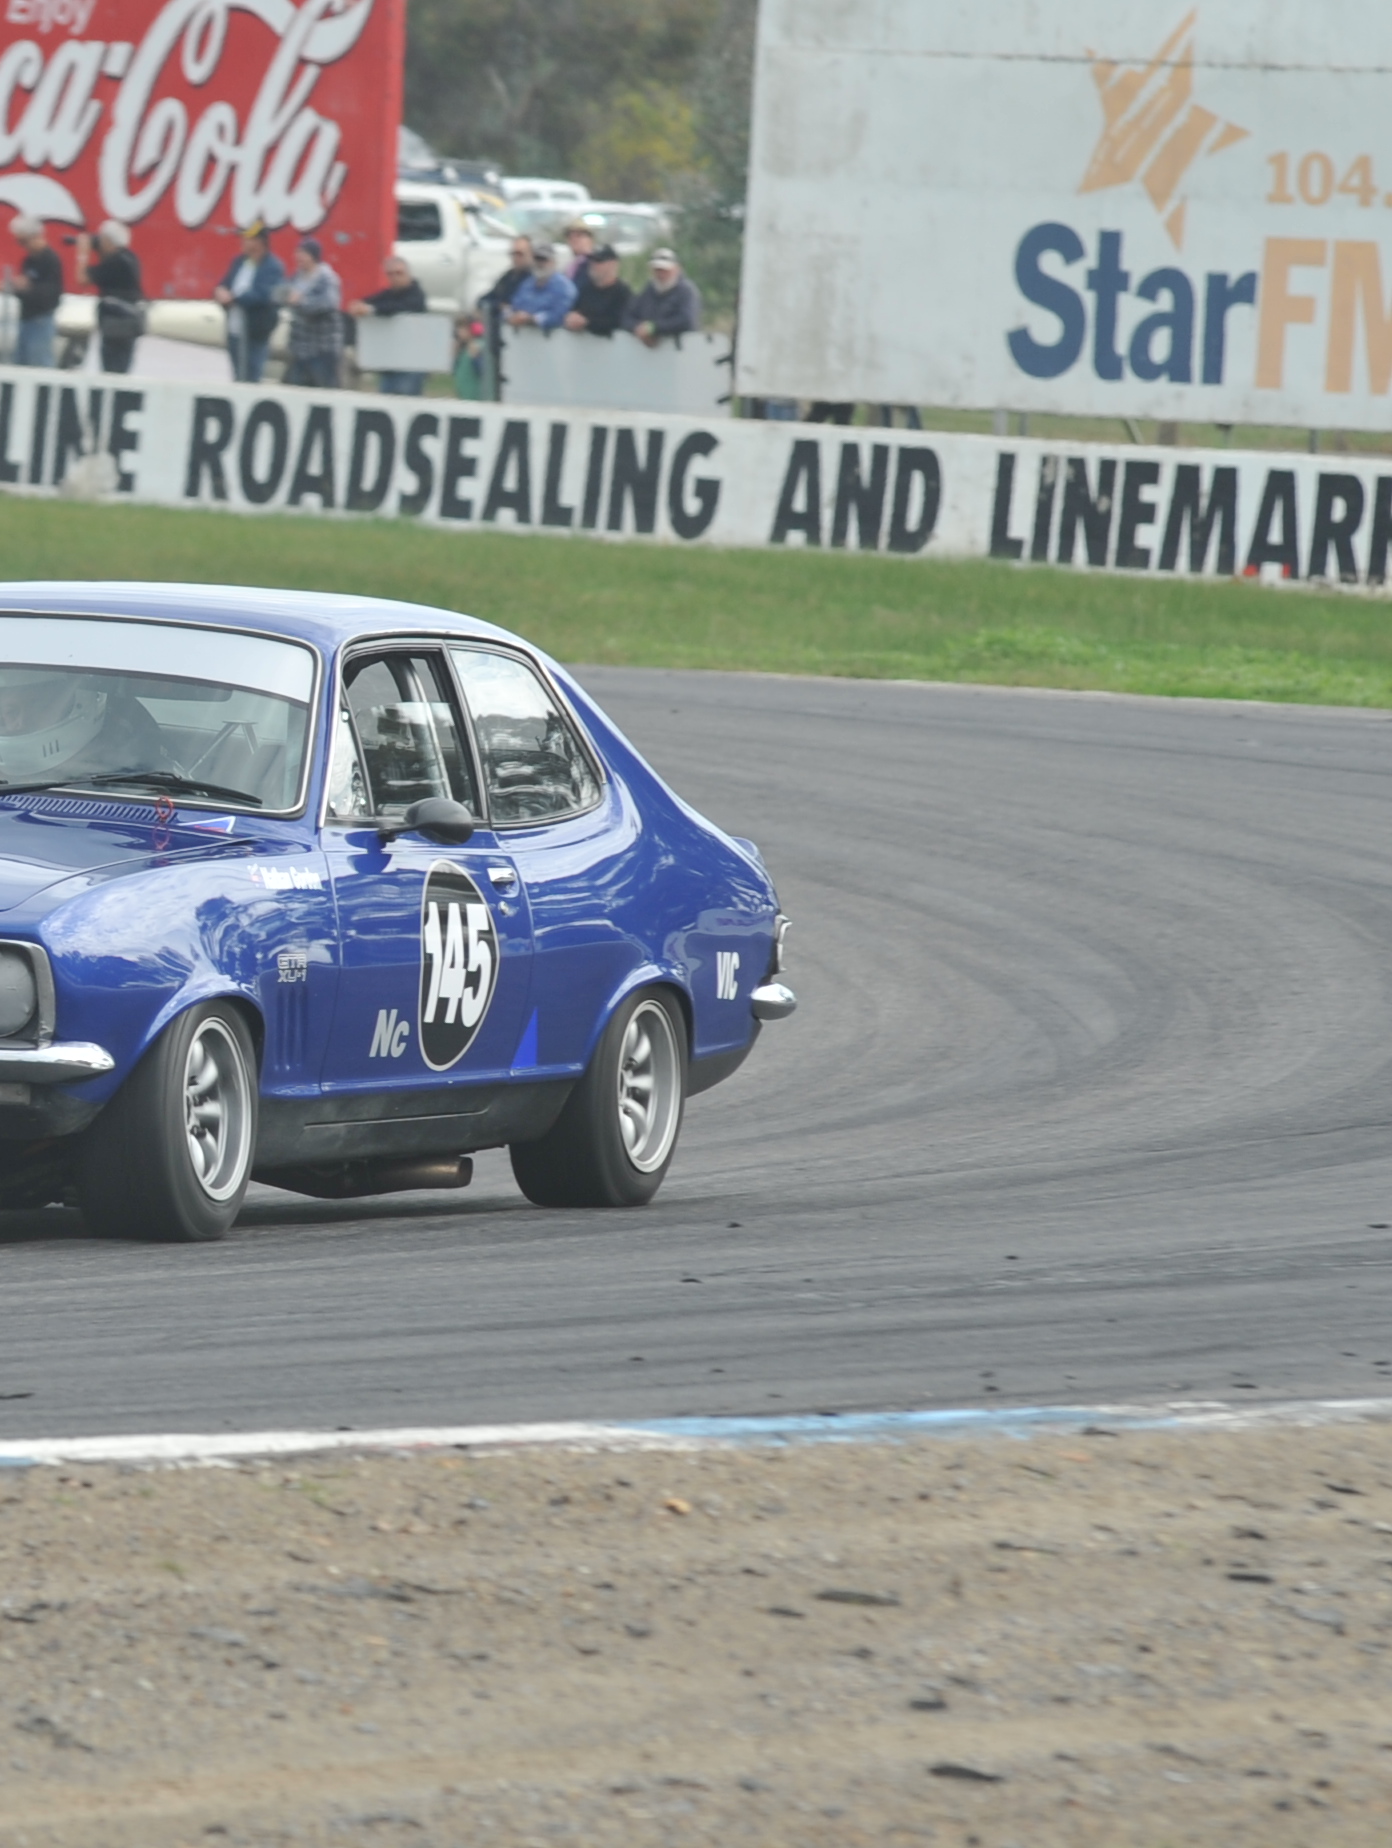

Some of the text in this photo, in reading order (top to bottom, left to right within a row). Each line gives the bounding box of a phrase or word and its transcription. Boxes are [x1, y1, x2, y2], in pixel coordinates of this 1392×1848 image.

[5, 0, 98, 35] Enjoy
[183, 395, 723, 540] ROADSEALING
[768, 438, 943, 555] AND
[277, 953, 307, 969] GTR
[423, 901, 490, 1028] 145
[369, 1008, 410, 1058] Nc
